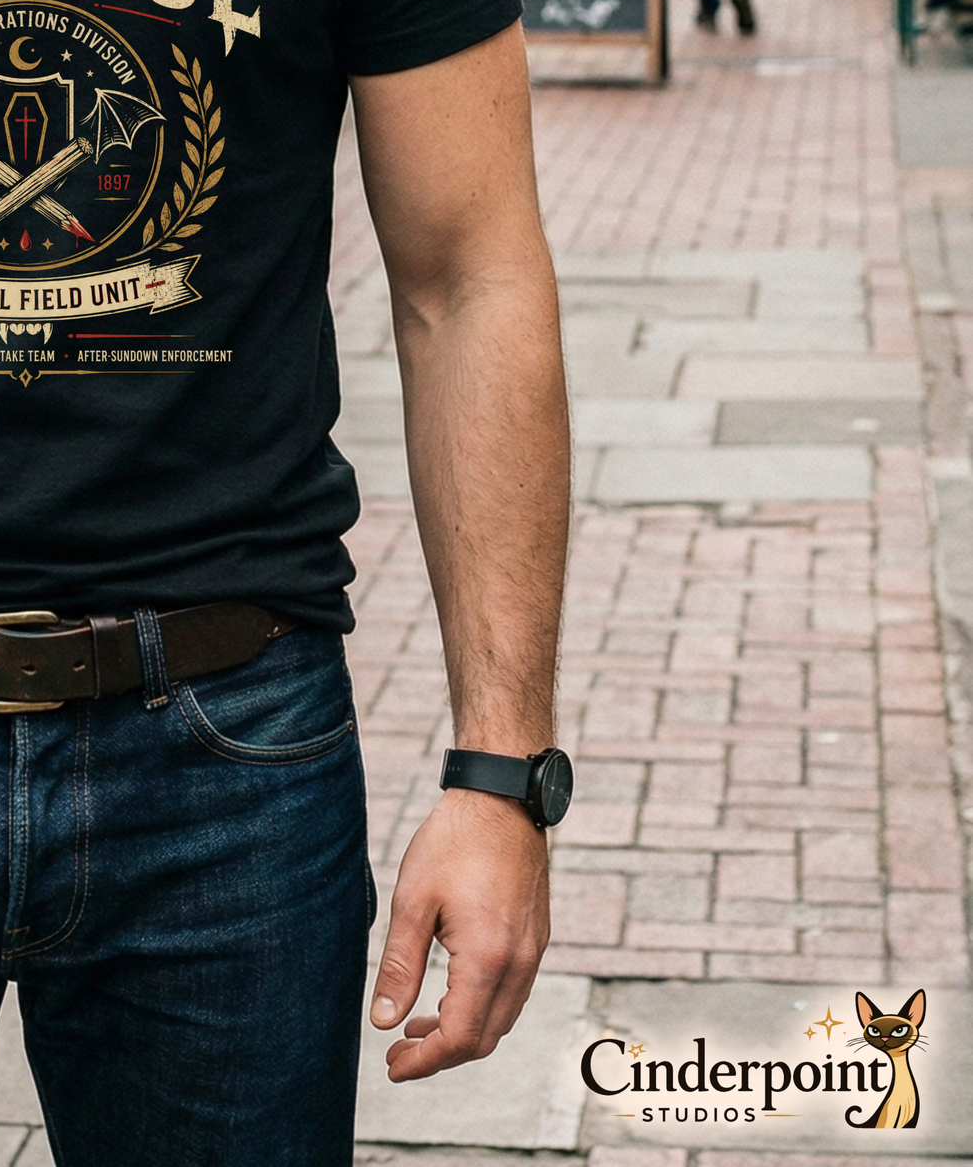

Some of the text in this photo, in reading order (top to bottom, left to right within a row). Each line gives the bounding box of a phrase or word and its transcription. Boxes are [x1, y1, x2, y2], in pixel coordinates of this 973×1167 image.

[71, 22, 137, 85] DIVISION
[97, 174, 131, 191] 1897
[20, 288, 82, 311] FIELD
[90, 277, 141, 307] UNIT
[27, 350, 55, 362] TEAM
[77, 350, 158, 362] AFTER-SUNDOWN
[161, 350, 233, 362] ENFORCEMENT
